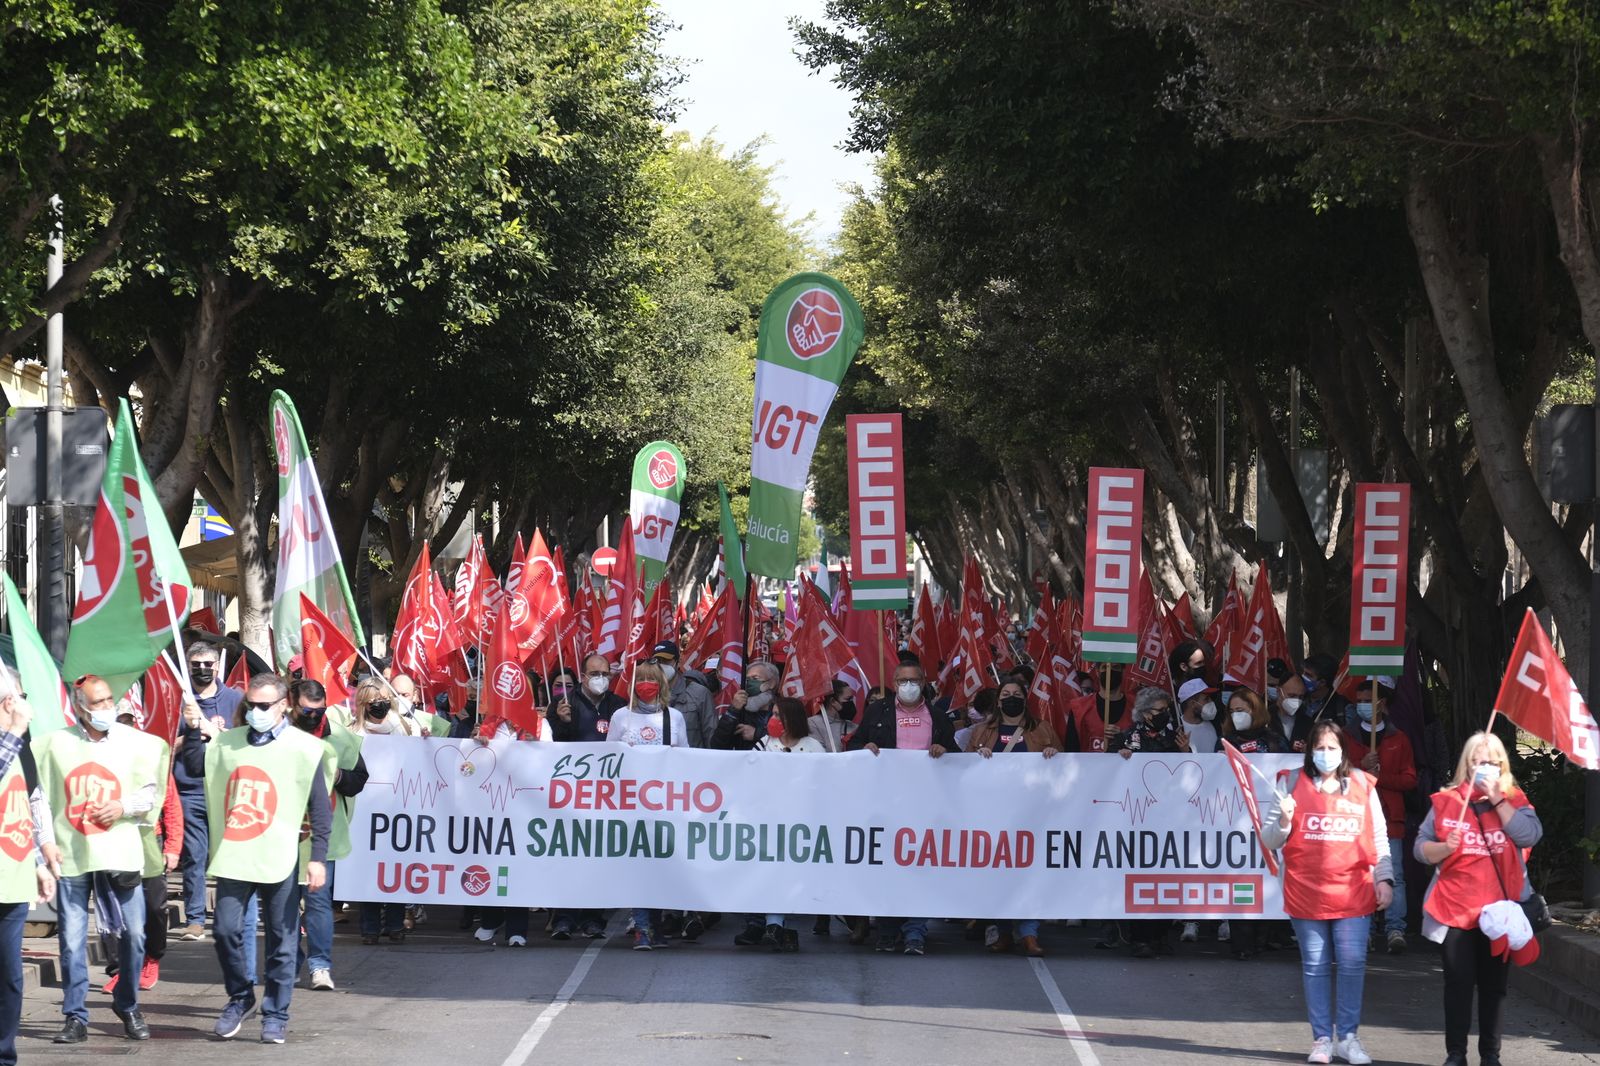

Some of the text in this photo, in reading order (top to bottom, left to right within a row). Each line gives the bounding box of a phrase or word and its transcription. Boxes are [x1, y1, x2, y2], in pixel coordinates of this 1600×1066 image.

[856, 422, 897, 574] CCOO
[1093, 476, 1134, 627] CCOO
[1360, 491, 1400, 641] CCOO
[552, 753, 625, 780] ES TU
[70, 774, 117, 809] UGT
[548, 779, 723, 813] DERECHO
[369, 813, 436, 853] POR
[447, 815, 516, 856] UNA
[526, 817, 675, 859] SANIDAD
[687, 811, 834, 863] PÚBLICA
[845, 826, 885, 865] DE
[894, 827, 1034, 869] CALIDAD
[1046, 830, 1082, 869] EN
[377, 862, 454, 894] UGT
[1133, 883, 1230, 905] CCOO
